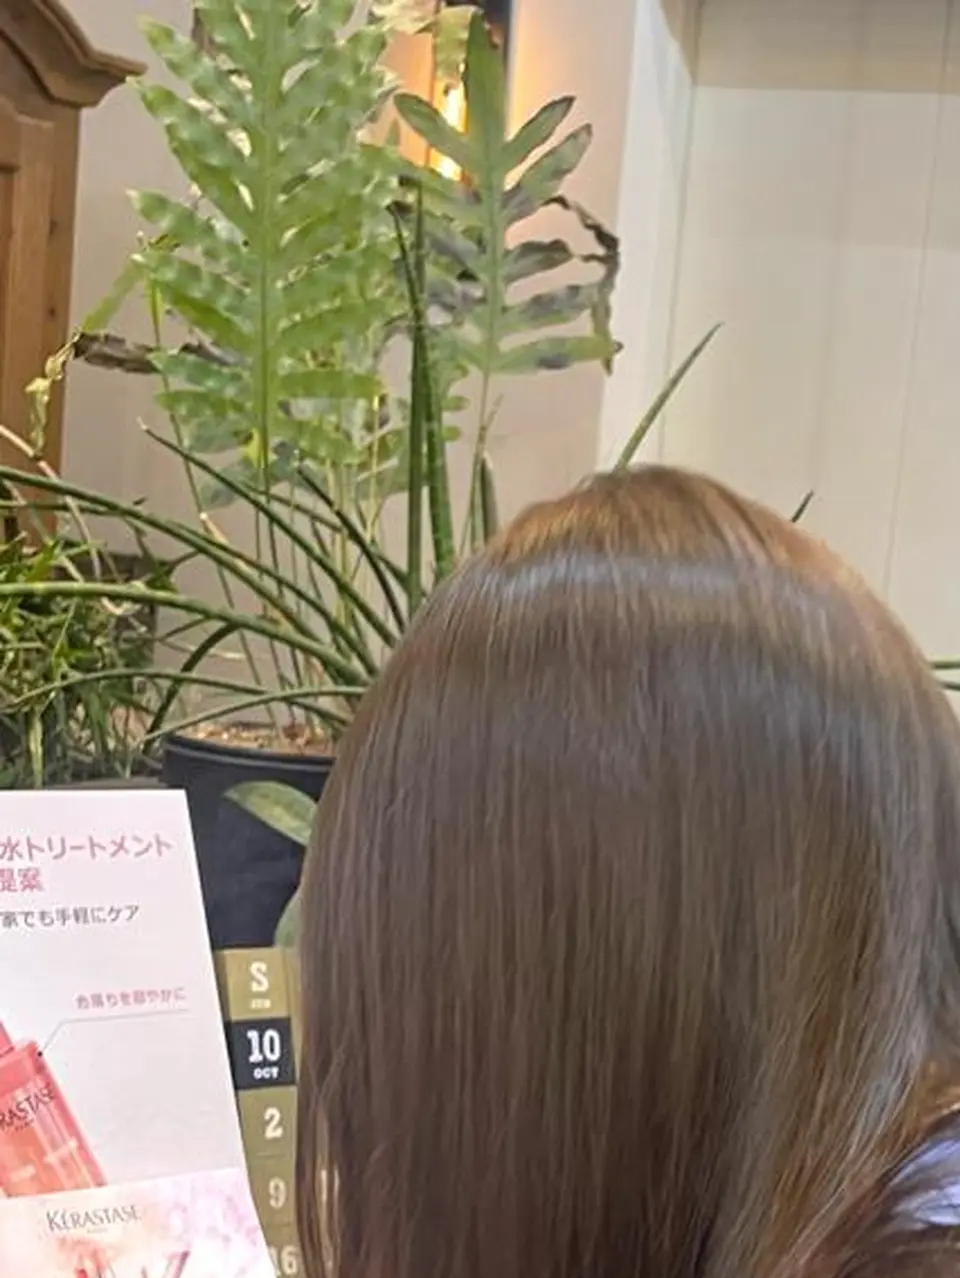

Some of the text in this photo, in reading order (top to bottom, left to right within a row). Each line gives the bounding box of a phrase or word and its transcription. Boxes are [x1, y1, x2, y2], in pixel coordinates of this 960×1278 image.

[250, 961, 269, 992] S
[246, 1029, 281, 1063] 10
[253, 1066, 279, 1080] OCT
[264, 1107, 283, 1139] 2
[268, 1177, 287, 1209] 9
